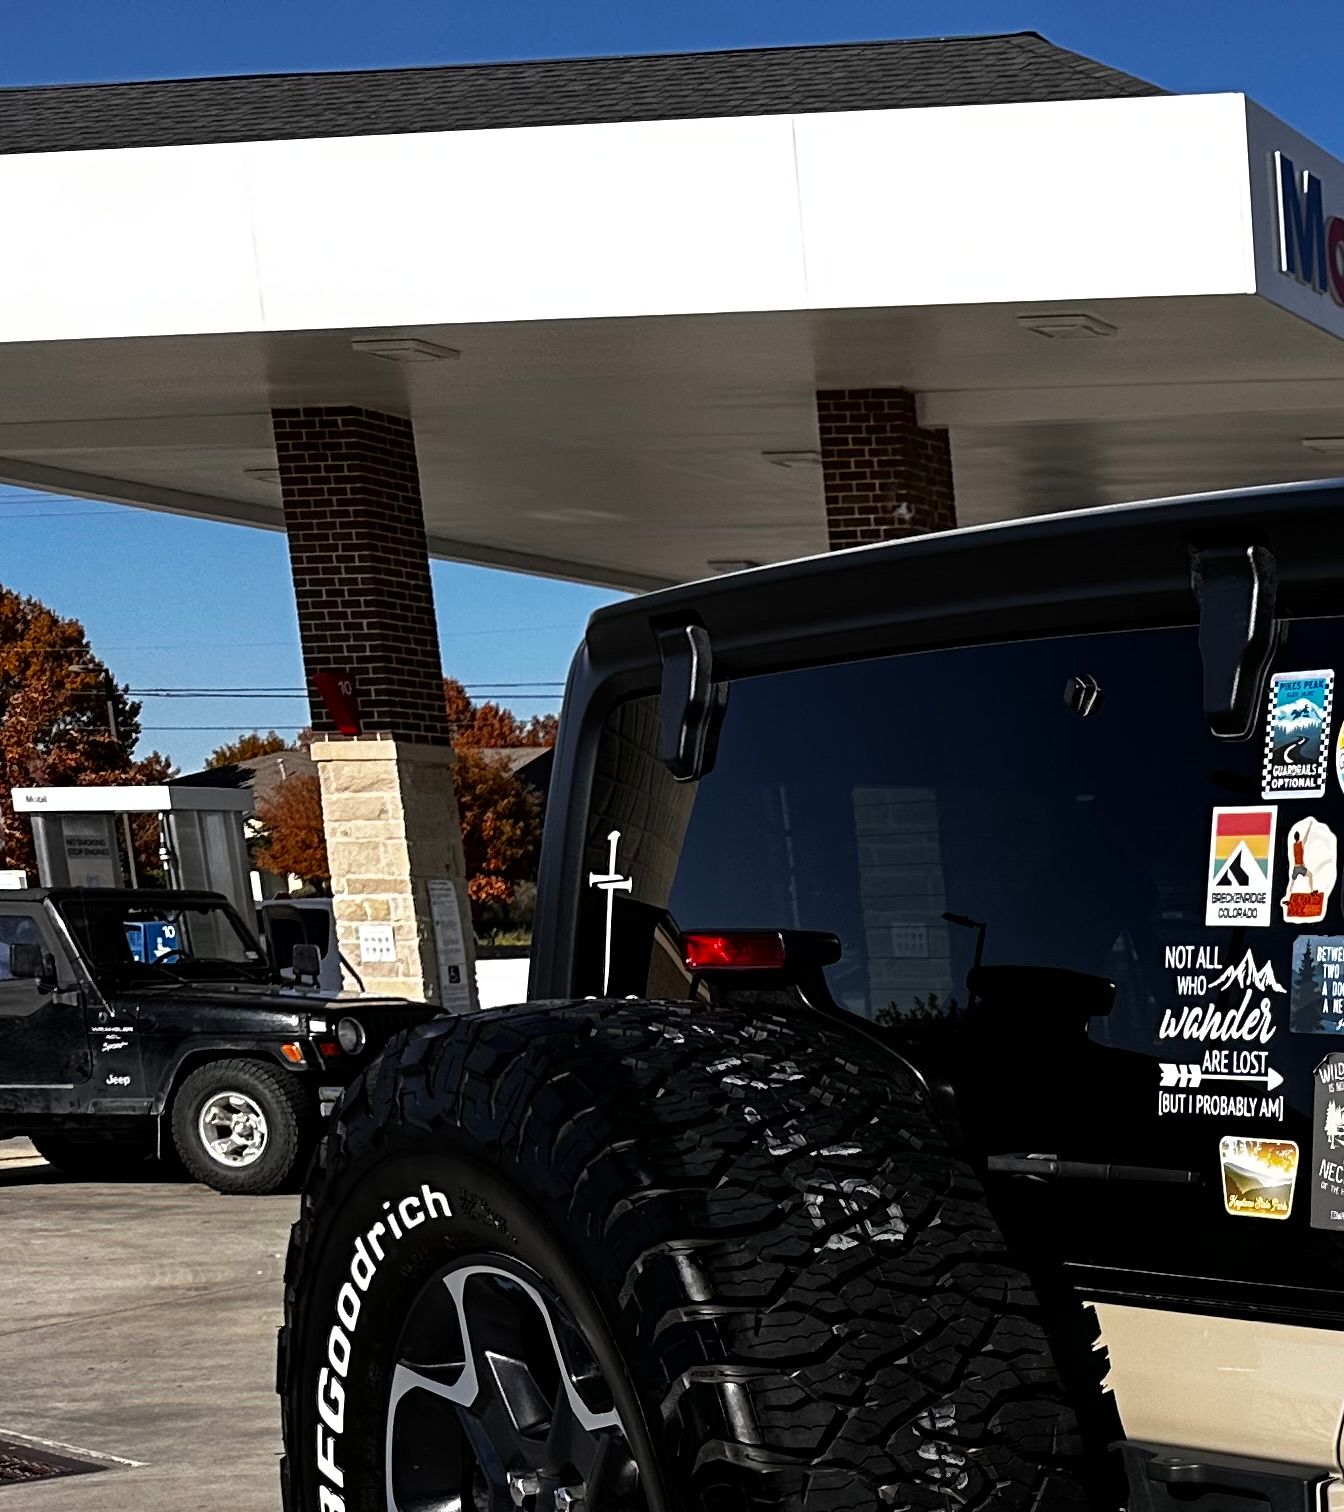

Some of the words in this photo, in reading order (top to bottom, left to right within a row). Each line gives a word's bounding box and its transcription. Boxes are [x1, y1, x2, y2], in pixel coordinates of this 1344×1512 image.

[1303, 680, 1325, 689] PEAK
[1271, 777, 1317, 789] OPTIONAL
[1218, 907, 1258, 919] COLORADO
[162, 925, 176, 939] 10
[1165, 945, 1195, 969] NOT
[1196, 945, 1223, 970] ALL
[1323, 963, 1340, 979] TWO
[1177, 975, 1207, 996] WHO
[1322, 980, 1328, 996] A
[1322, 998, 1329, 1014] A
[1159, 988, 1277, 1044] wander
[1202, 1050, 1229, 1073] ARE
[1232, 1050, 1269, 1075] LOST
[105, 1073, 131, 1087] Jeep
[1328, 1083, 1335, 1093] IS
[1188, 1094, 1193, 1113] I
[1196, 1094, 1257, 1118] PROBABLY
